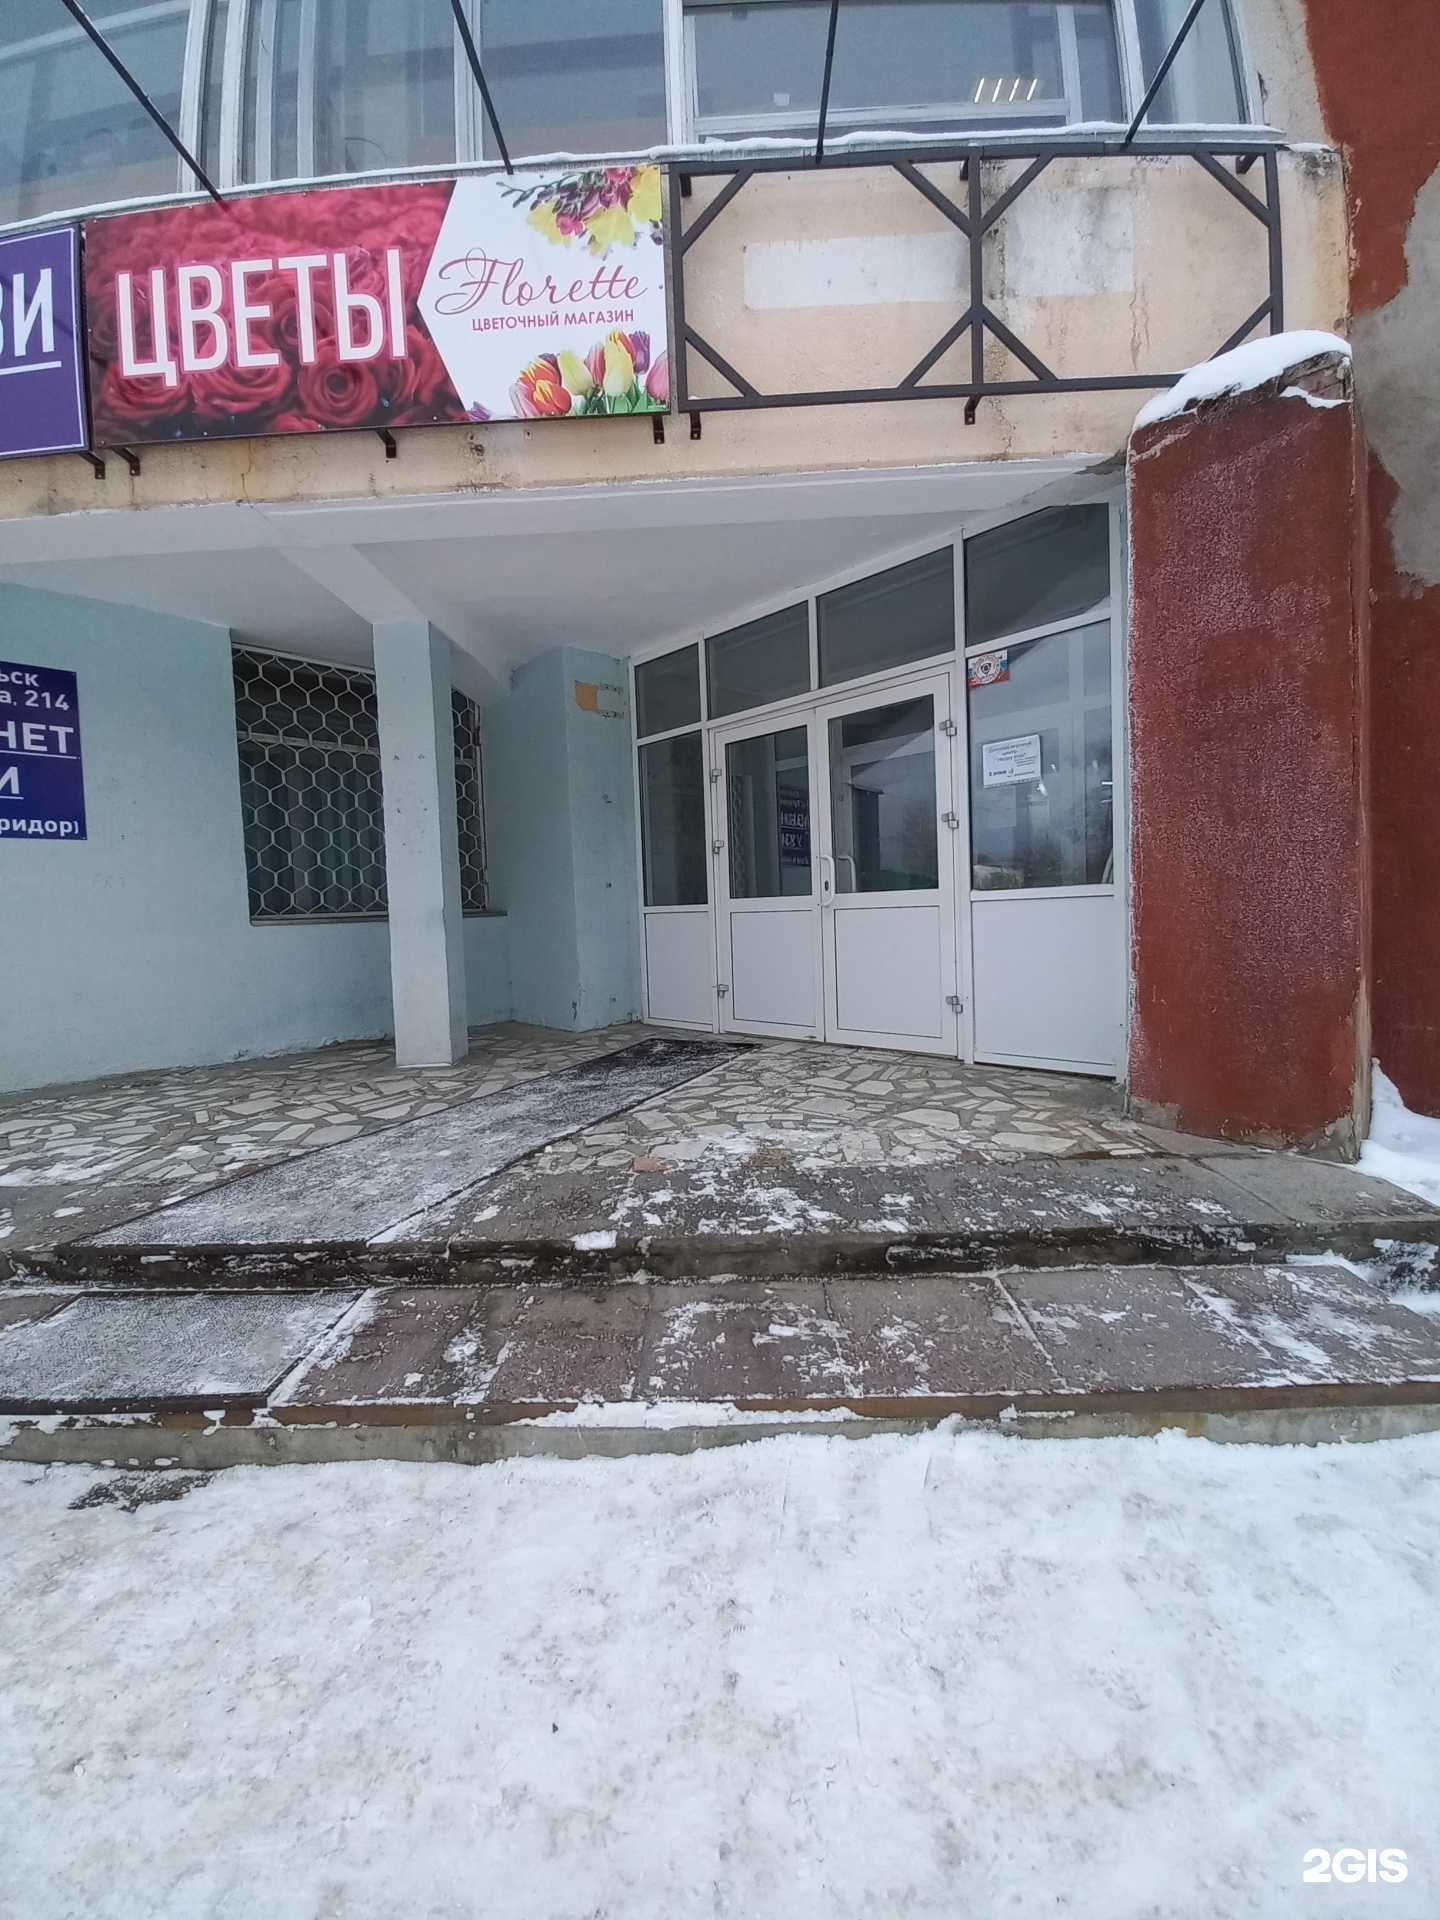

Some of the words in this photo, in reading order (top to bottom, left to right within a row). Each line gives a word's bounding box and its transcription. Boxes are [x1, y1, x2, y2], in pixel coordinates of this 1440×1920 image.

[434, 247, 648, 315] Florette
[0, 267, 54, 357] И
[117, 248, 407, 387] ЦВЕТЫ
[472, 311, 560, 332] ЦВЕТОЧНЫЙ
[564, 309, 635, 326] МАГАЗИН
[24, 689, 70, 710] 214
[0, 818, 79, 837] ридор)
